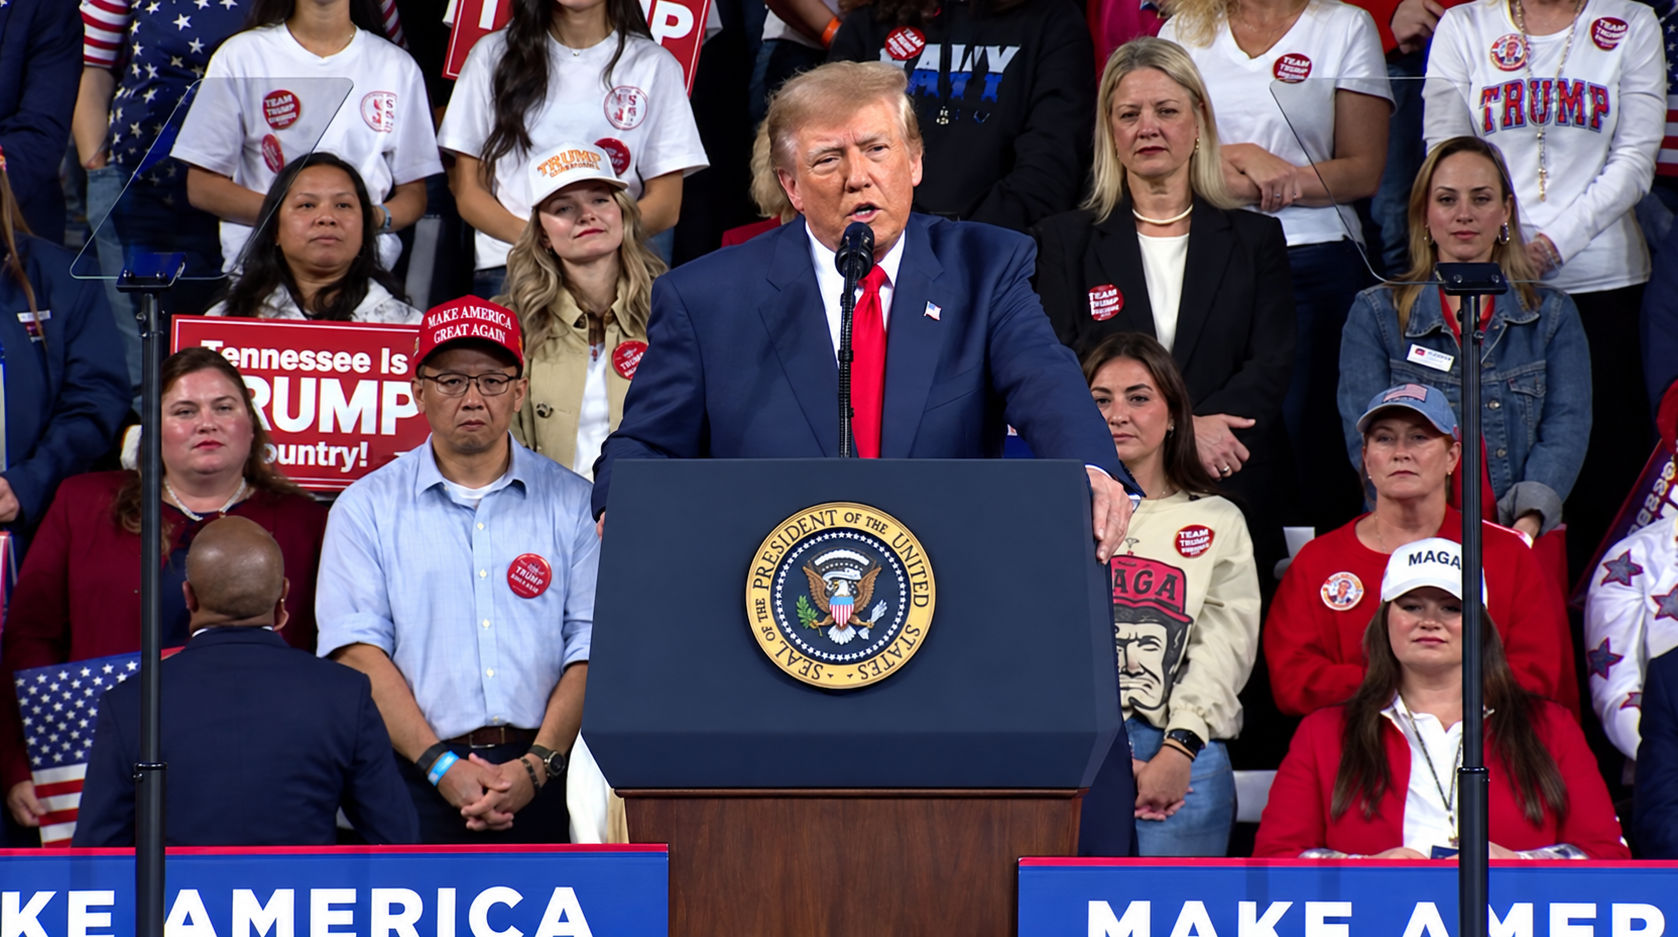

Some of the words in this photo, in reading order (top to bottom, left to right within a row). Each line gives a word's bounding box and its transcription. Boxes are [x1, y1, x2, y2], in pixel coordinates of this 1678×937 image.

[903, 28, 924, 47] TEAM
[1600, 19, 1627, 32] TEAM
[1284, 56, 1310, 67] TEAM
[266, 95, 292, 107] TEAM
[1480, 78, 1610, 135] TRUMP
[537, 149, 602, 176] TRUMP
[1089, 289, 1117, 300] TEAM
[428, 308, 458, 329] MAKE
[461, 306, 512, 330] AMERICA
[434, 323, 459, 343] GREAT
[471, 323, 506, 344] AGAIN
[201, 340, 371, 373] Tennessee
[380, 347, 408, 375] Is
[241, 375, 419, 436] RUMP
[264, 441, 369, 473] ountry!
[844, 512, 862, 524] OF
[865, 516, 888, 535] THE
[1179, 529, 1209, 539] TEAM
[753, 510, 837, 591] PRESIDENT
[1408, 550, 1461, 570] MAGA
[515, 565, 543, 585] TRUMP
[892, 532, 929, 608] UNITED
[1113, 569, 1178, 600] AGA
[755, 598, 768, 623] THE
[761, 626, 776, 642] OF
[775, 640, 823, 680] SEAL
[858, 624, 921, 680] STATES
[163, 886, 594, 937] AMERICA
[1088, 900, 1352, 937] MAKE
